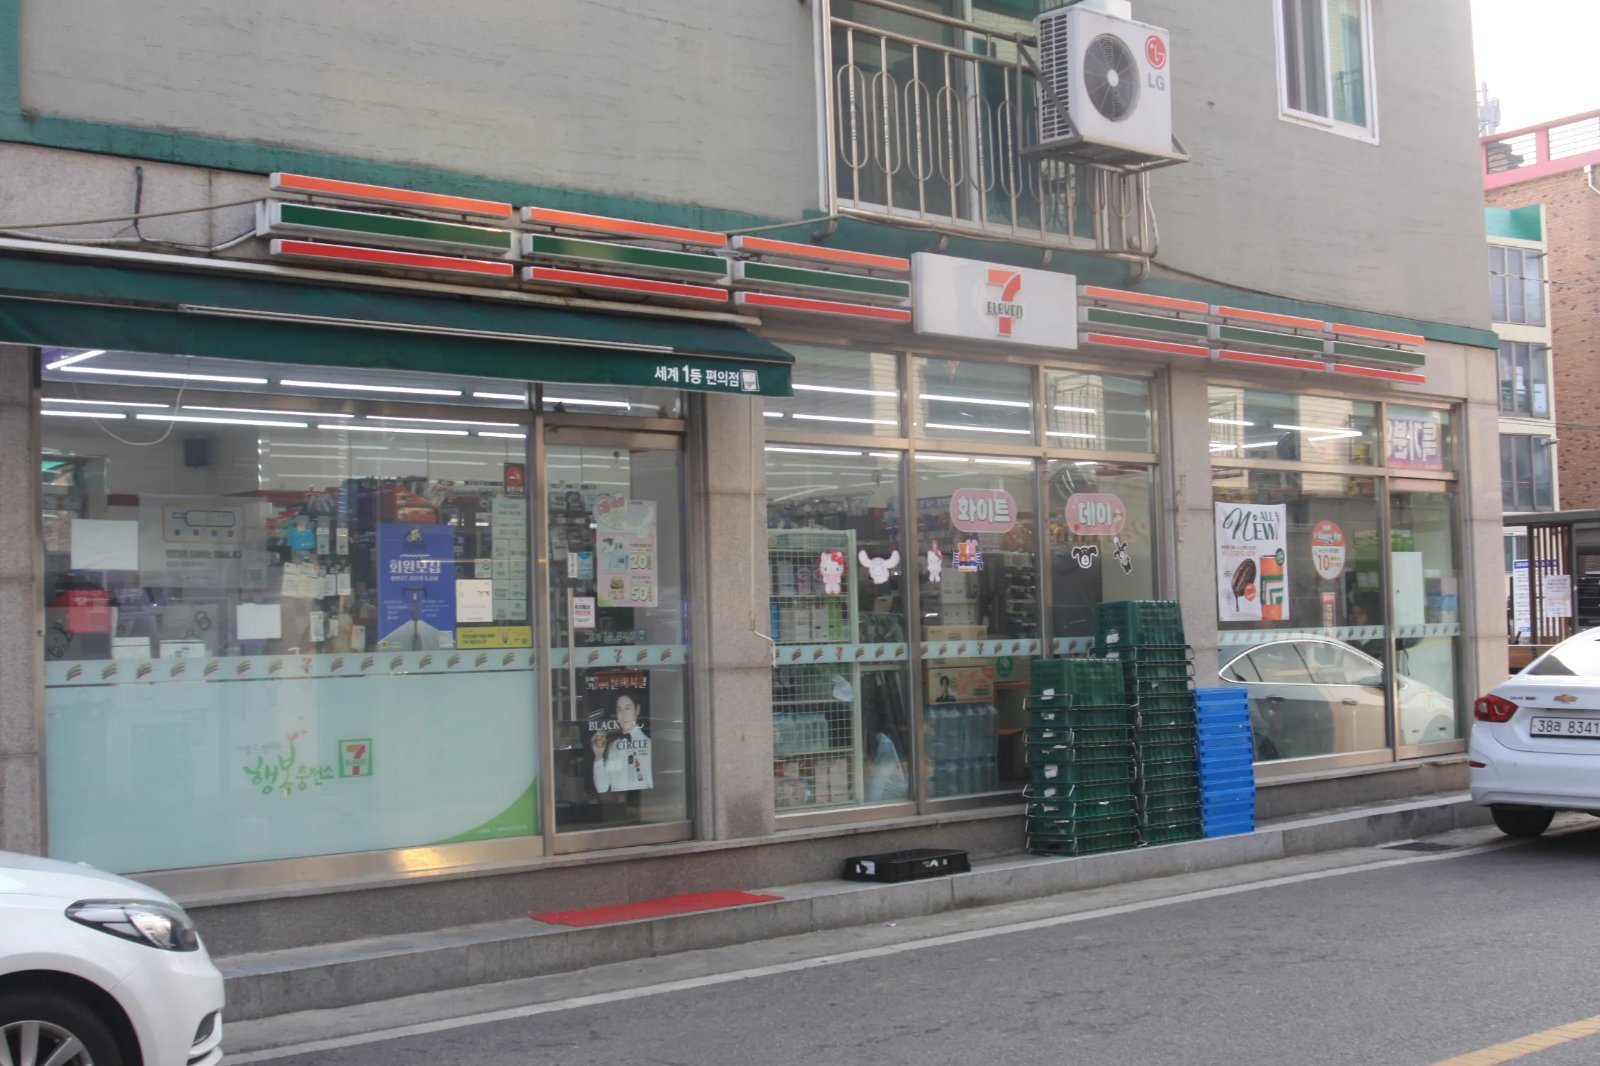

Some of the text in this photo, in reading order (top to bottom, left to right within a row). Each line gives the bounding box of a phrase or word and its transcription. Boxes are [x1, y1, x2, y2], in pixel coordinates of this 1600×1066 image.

[1148, 72, 1166, 91] LG
[986, 269, 1021, 336] 7
[654, 365, 740, 387] 세계 1등 편의점
[957, 496, 1010, 522] 화이트
[1077, 502, 1112, 526] 데이
[1260, 511, 1275, 521] ALL
[389, 559, 441, 573] 회원모집
[588, 720, 620, 731] BLACK
[1567, 721, 1599, 734] 8341
[616, 740, 649, 751] CIRCLE
